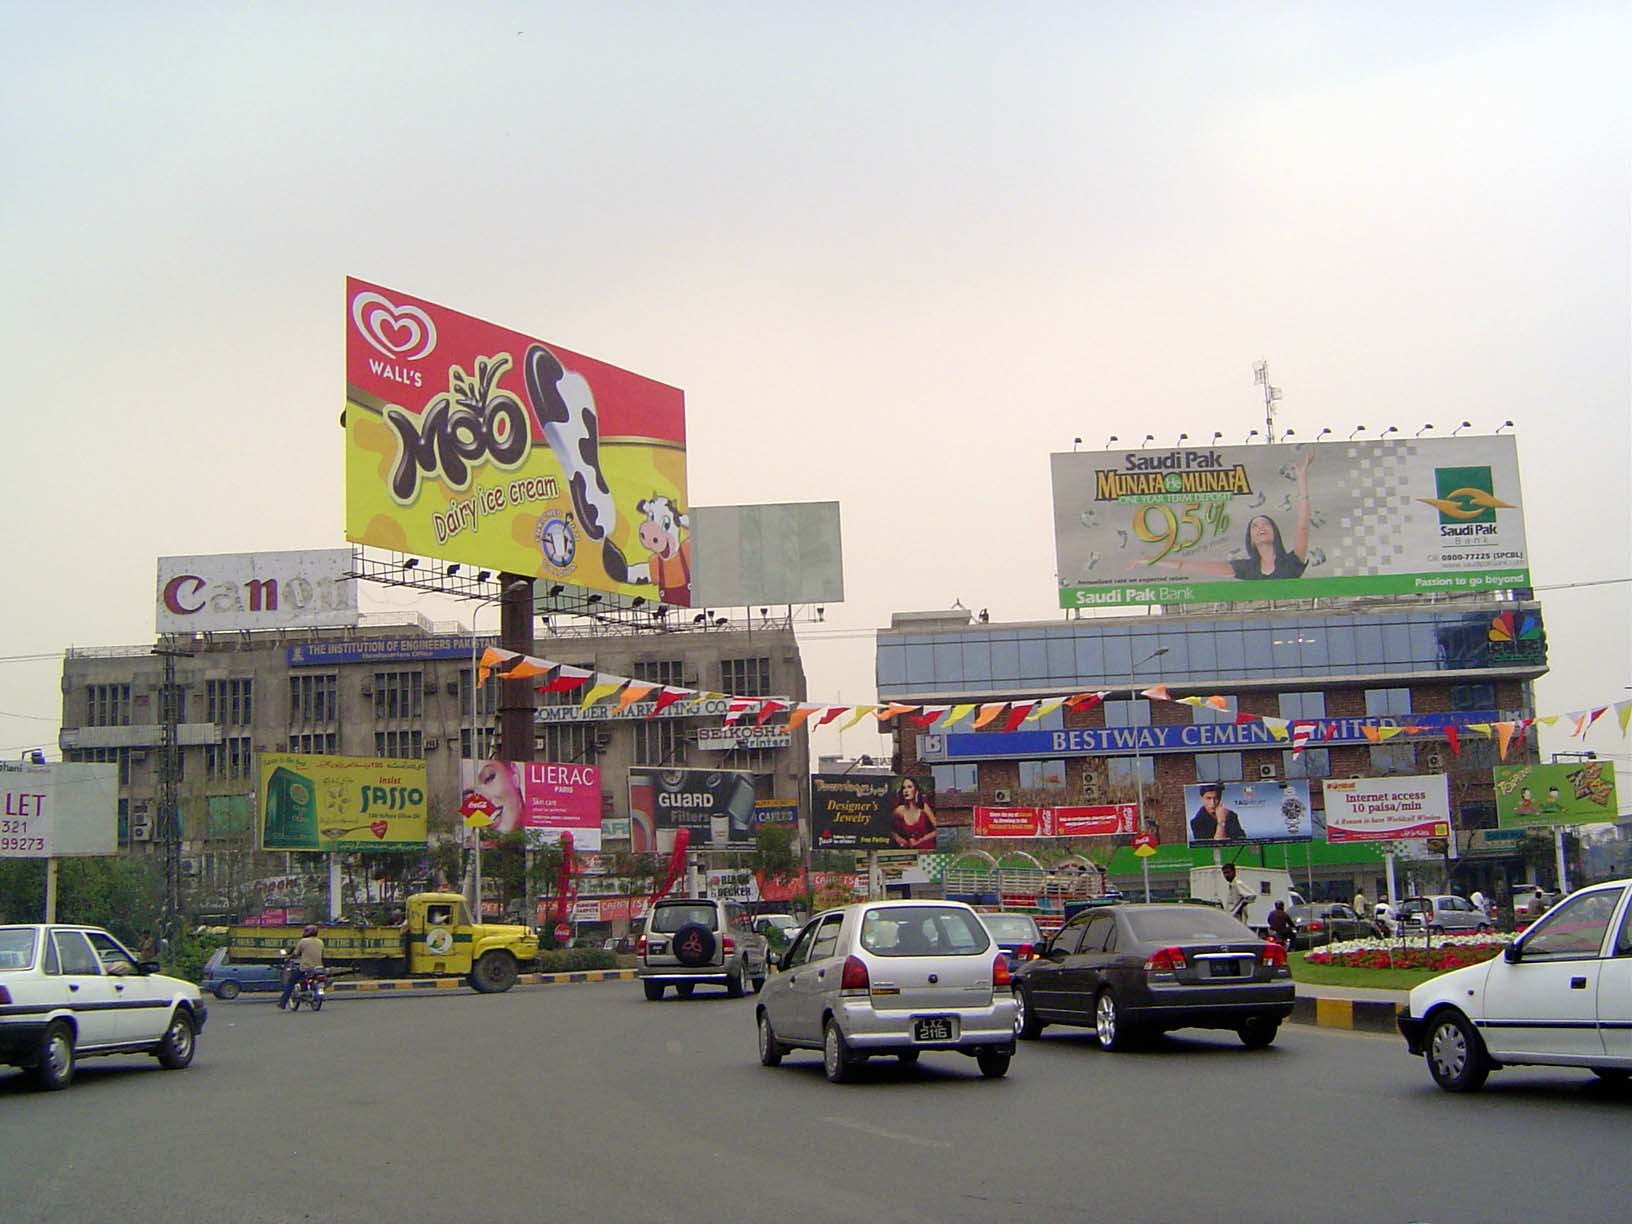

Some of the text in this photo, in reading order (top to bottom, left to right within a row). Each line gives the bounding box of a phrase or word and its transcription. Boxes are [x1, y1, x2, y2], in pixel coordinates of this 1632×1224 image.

[368, 358, 422, 388] WALL'S
[1125, 451, 1223, 471] Saudi Pak
[1095, 470, 1165, 500] MUNAFA
[1181, 464, 1252, 495] MUNAFA
[433, 476, 559, 543] Dairy ice cream
[1440, 524, 1497, 537] Saudi Pak
[1415, 574, 1525, 588] Passion to go beyond
[1076, 586, 1194, 604] Saudi Pak Bank
[309, 637, 497, 655] THE INSTITUTION OF ENGINEERS PAKSTAN
[535, 705, 608, 720] OMPUER
[1053, 728, 1169, 750] BESTWAY
[1182, 724, 1276, 745] CEMEN
[532, 765, 594, 785] LIERAC
[6, 793, 46, 816] LET
[360, 785, 424, 813] SASSO
[1345, 791, 1426, 803] Internet access
[826, 799, 879, 813] Designer's
[1351, 801, 1422, 814] 10 paisa/min
[833, 811, 872, 826] Jewelry
[2, 820, 28, 833] 321
[2, 838, 44, 850] 99273
[721, 874, 750, 885] BLA
[718, 886, 751, 897] DECKER
